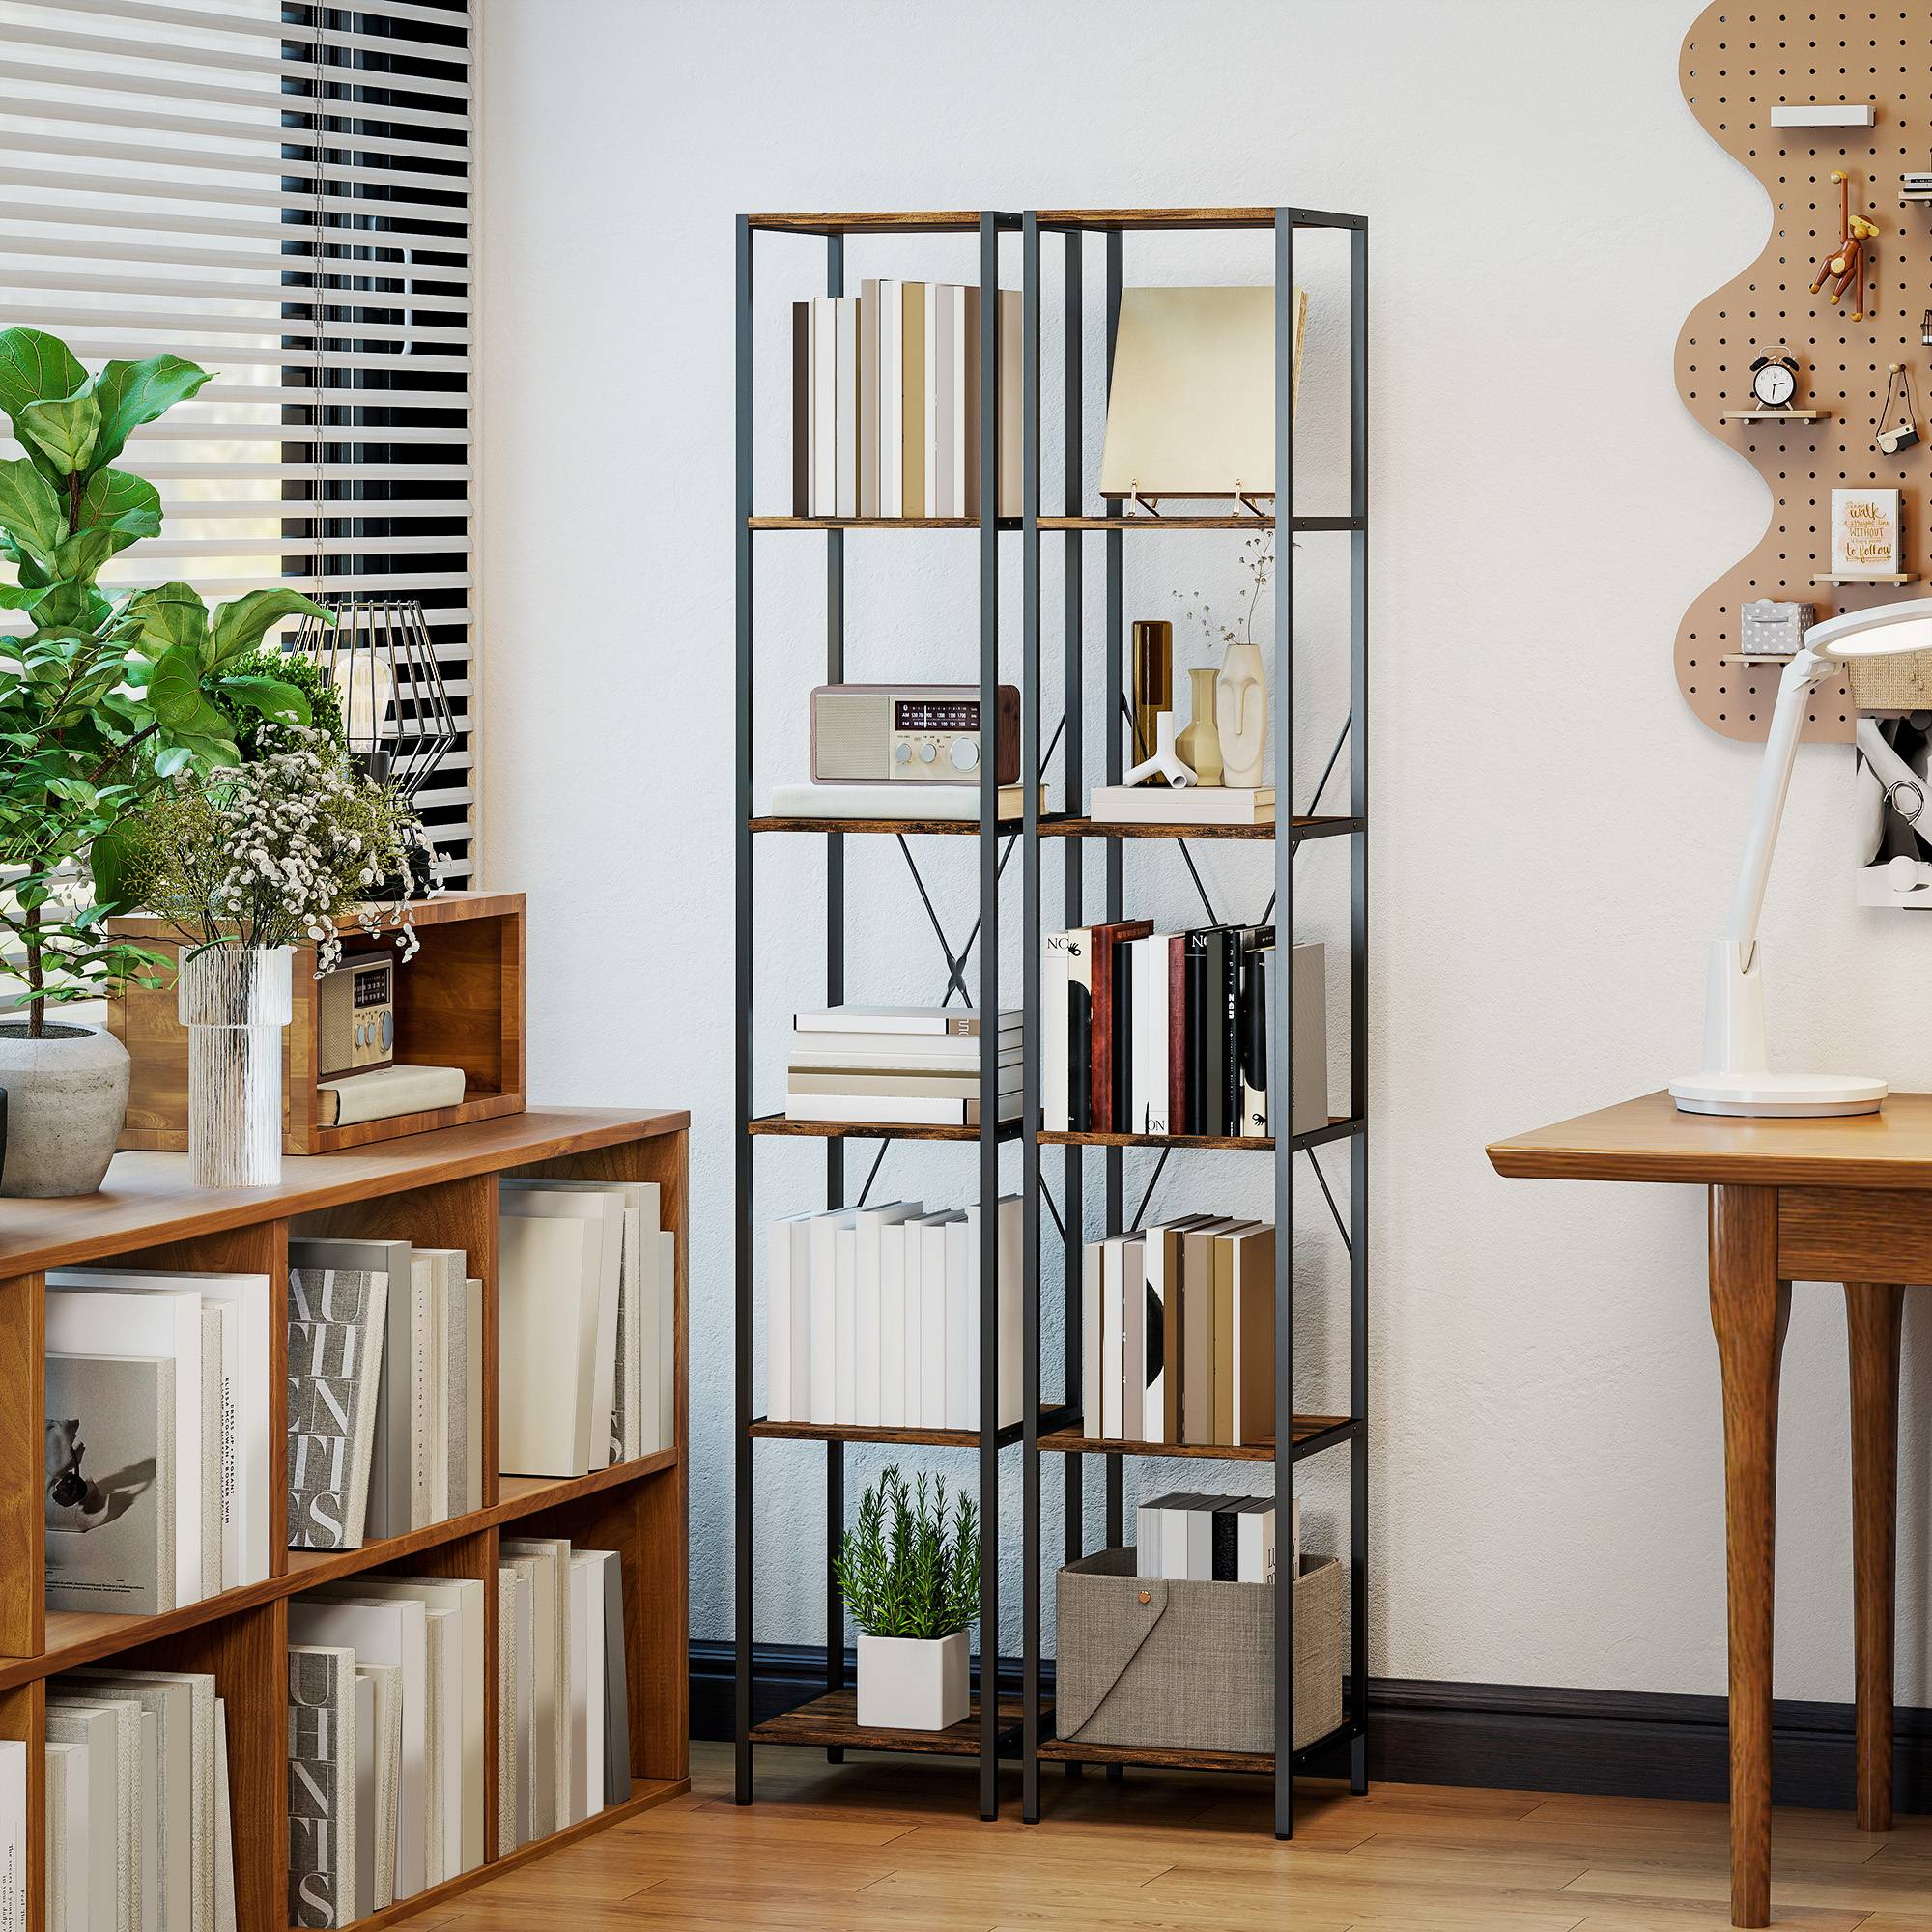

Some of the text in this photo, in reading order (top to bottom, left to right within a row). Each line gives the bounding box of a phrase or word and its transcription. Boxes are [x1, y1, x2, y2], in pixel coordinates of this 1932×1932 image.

[1850, 502, 1886, 520] walk
[1849, 527, 1885, 538] WITHOUT
[1844, 542, 1892, 563] to follow
